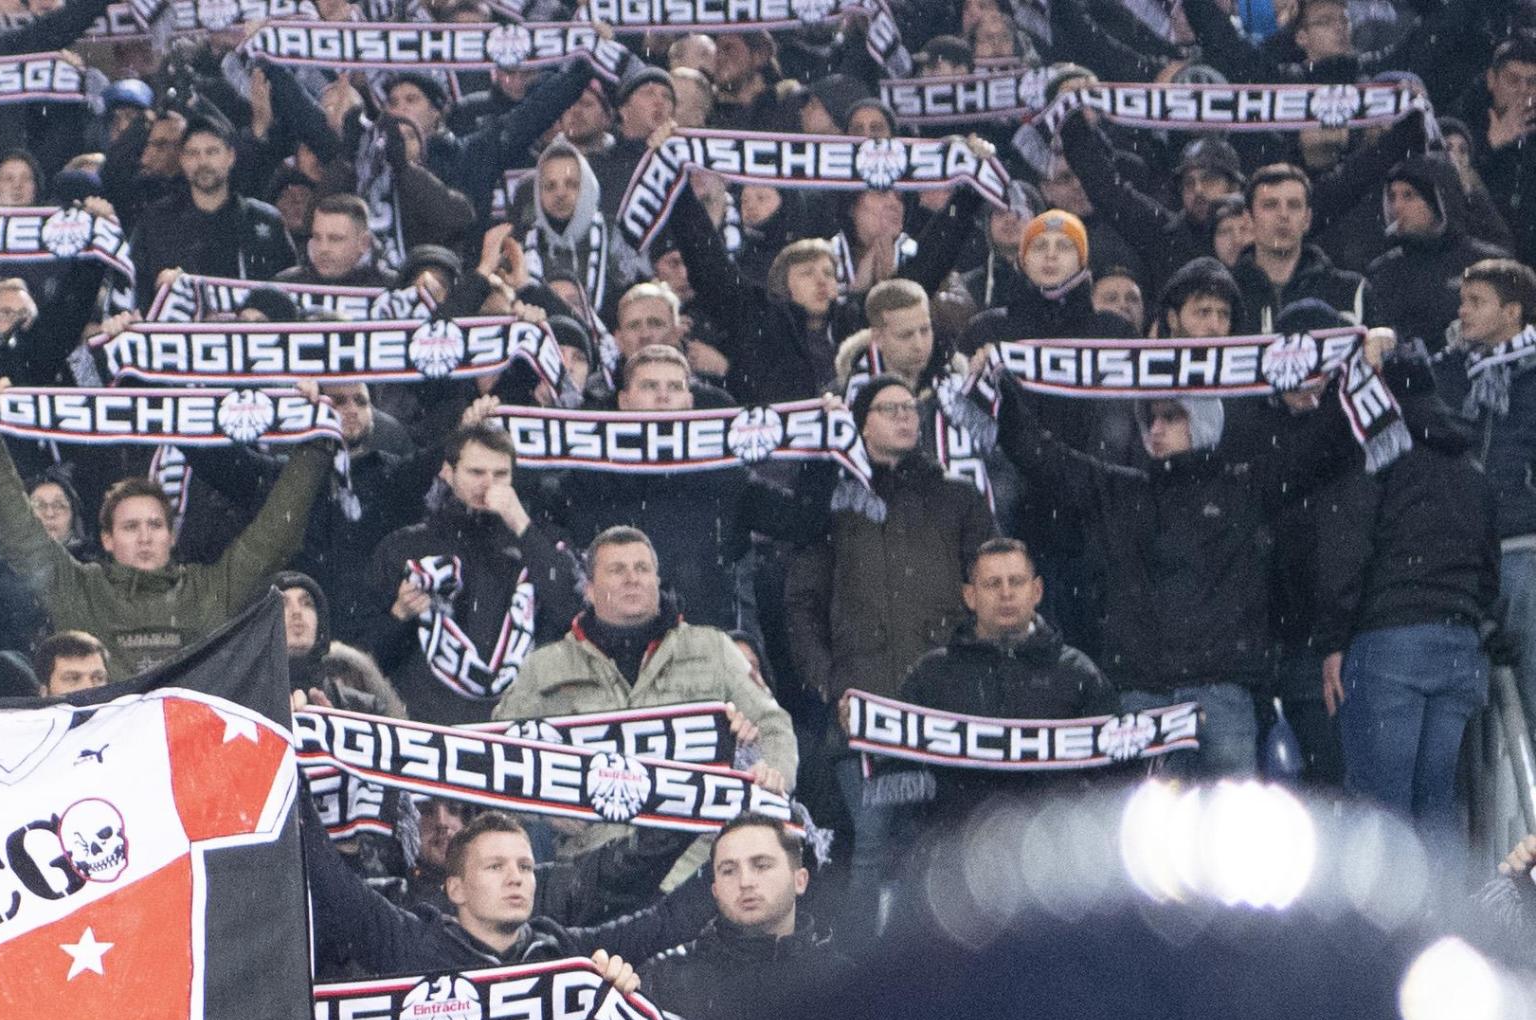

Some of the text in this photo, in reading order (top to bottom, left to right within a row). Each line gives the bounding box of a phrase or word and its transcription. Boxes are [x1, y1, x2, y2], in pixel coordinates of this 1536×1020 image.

[103, 330, 408, 374] MAGISCHE
[655, 773, 791, 821] SGE
[412, 1000, 472, 1017] Eintracht
